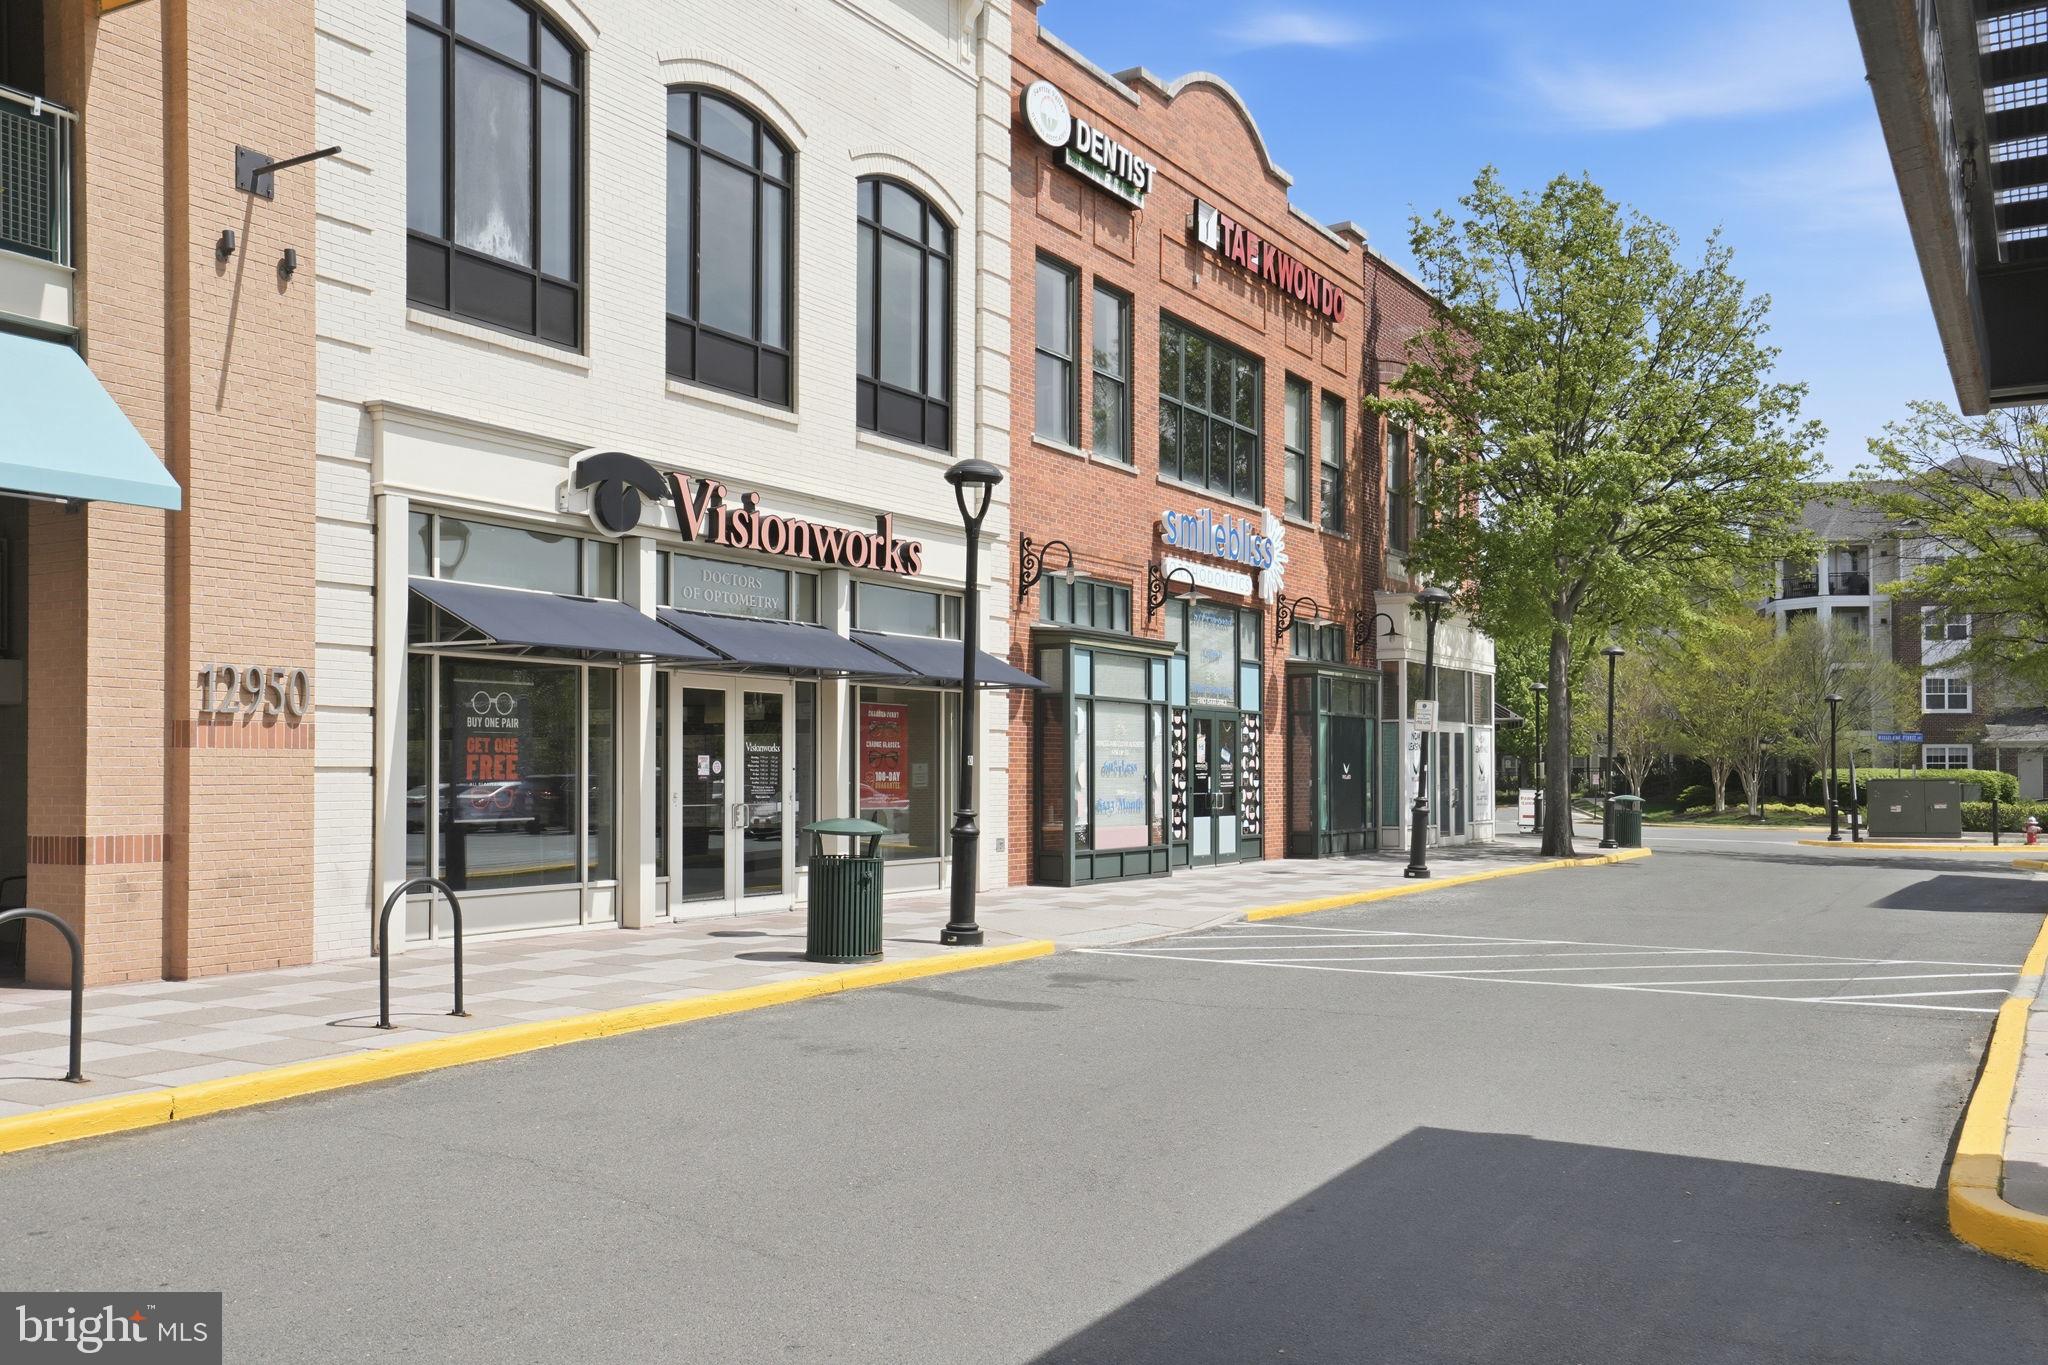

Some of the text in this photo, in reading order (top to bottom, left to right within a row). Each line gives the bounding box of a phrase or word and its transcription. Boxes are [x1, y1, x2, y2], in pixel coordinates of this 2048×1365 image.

[1075, 118, 1157, 194] DENTIST
[1219, 213, 1346, 324] TAE KWON DO
[664, 472, 922, 576] Visionworks
[1162, 508, 1275, 570] smilebliss
[702, 569, 763, 590] DOCTORS
[683, 586, 779, 609] OF OPTOMETRY
[199, 663, 310, 716] 12950
[467, 716, 519, 729] BUY ONE PAIR
[466, 736, 519, 754] GET ONE
[745, 741, 781, 753] Visionworks
[466, 754, 519, 780] FREE
